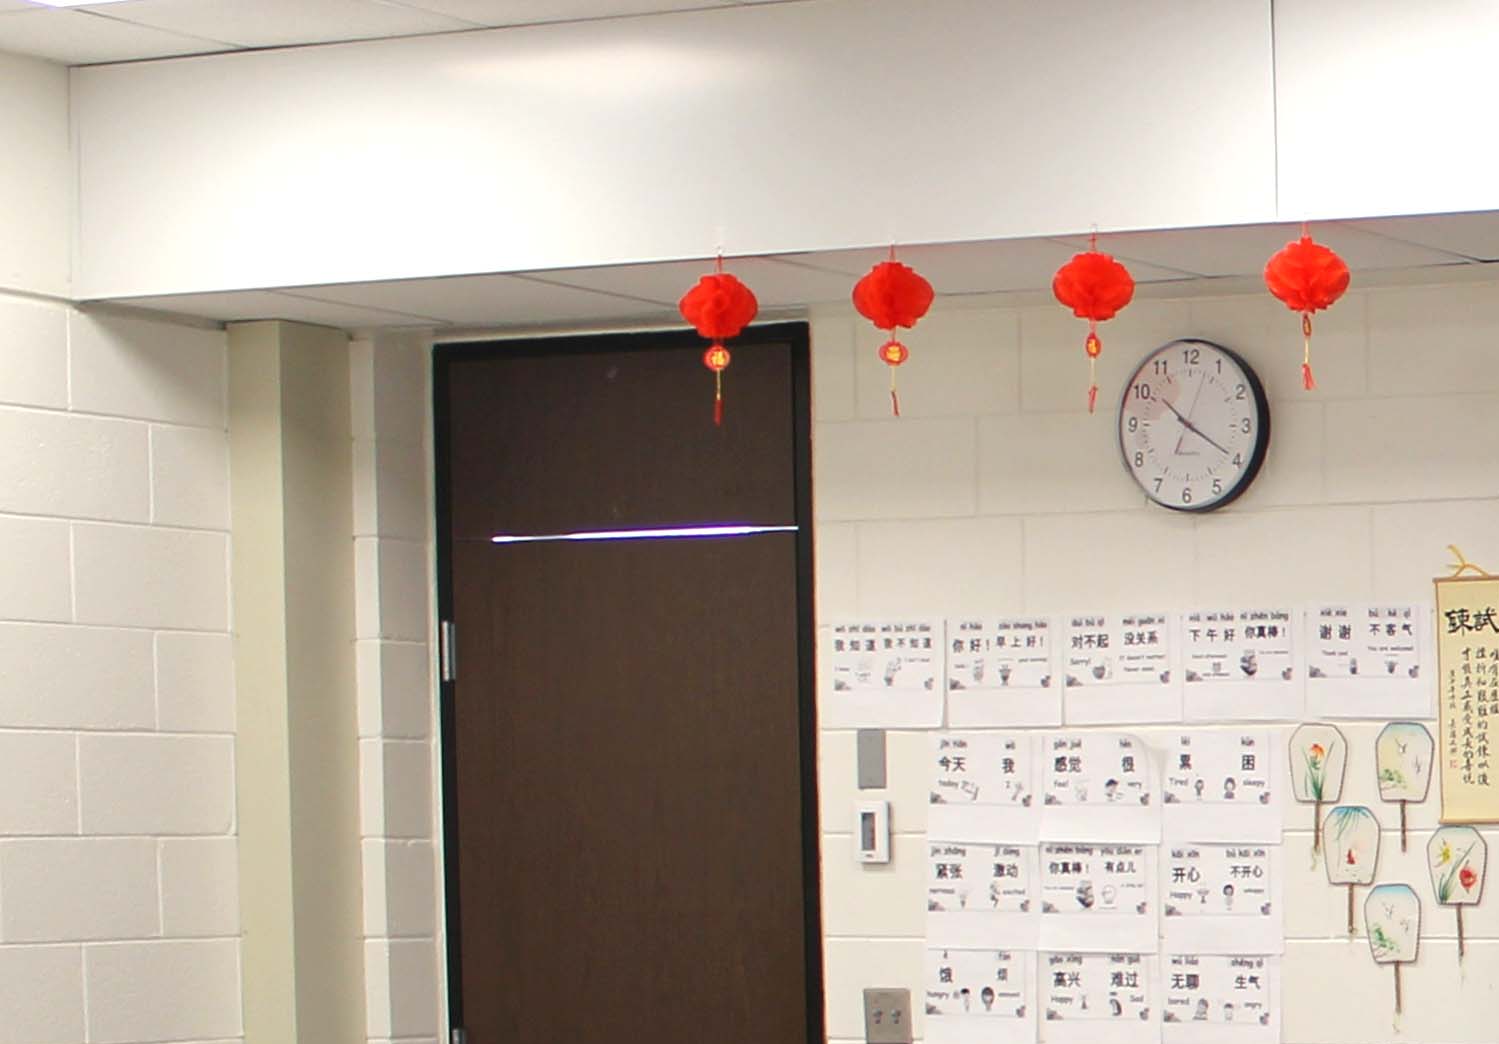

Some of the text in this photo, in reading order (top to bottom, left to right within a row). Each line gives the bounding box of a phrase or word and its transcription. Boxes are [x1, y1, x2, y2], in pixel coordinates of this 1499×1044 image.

[1184, 350, 1200, 365] 12
[1154, 360, 1167, 375] 11
[1215, 359, 1222, 374] 1
[1134, 384, 1150, 399] 10
[1236, 384, 1246, 400] 2
[1128, 417, 1138, 432] 9
[1241, 418, 1250, 434] 3
[1135, 452, 1143, 467] 8
[1232, 453, 1243, 468] 4
[1154, 478, 1163, 493] 7
[1212, 479, 1221, 495] 5
[1182, 488, 1191, 503] 6
[1189, 628, 1235, 641] 下午好
[1245, 625, 1285, 639] 你真棒！
[1320, 624, 1351, 640] 谢谢
[1369, 624, 1412, 636] 不客气
[1071, 633, 1109, 648] 对不起
[1124, 631, 1158, 645] 没关系
[938, 756, 968, 772] 今天
[1002, 758, 1015, 773] 我
[1055, 756, 1082, 772] 感觉
[1122, 756, 1135, 772] 很
[1179, 753, 1191, 769] 累
[1242, 754, 1255, 770] 困
[936, 863, 963, 879] 紧张
[993, 863, 1018, 878] 激动
[1049, 861, 1089, 874] 你真棒！
[1105, 861, 1136, 873] 有点儿
[1172, 866, 1200, 883] 开心
[1230, 865, 1263, 878] 不开心
[940, 966, 953, 983] 饿
[997, 968, 1008, 982] 烦
[1053, 971, 1080, 987] 高兴
[1111, 971, 1138, 987] 难过
[1171, 974, 1200, 990] 无聊
[1234, 974, 1261, 990] 生气
